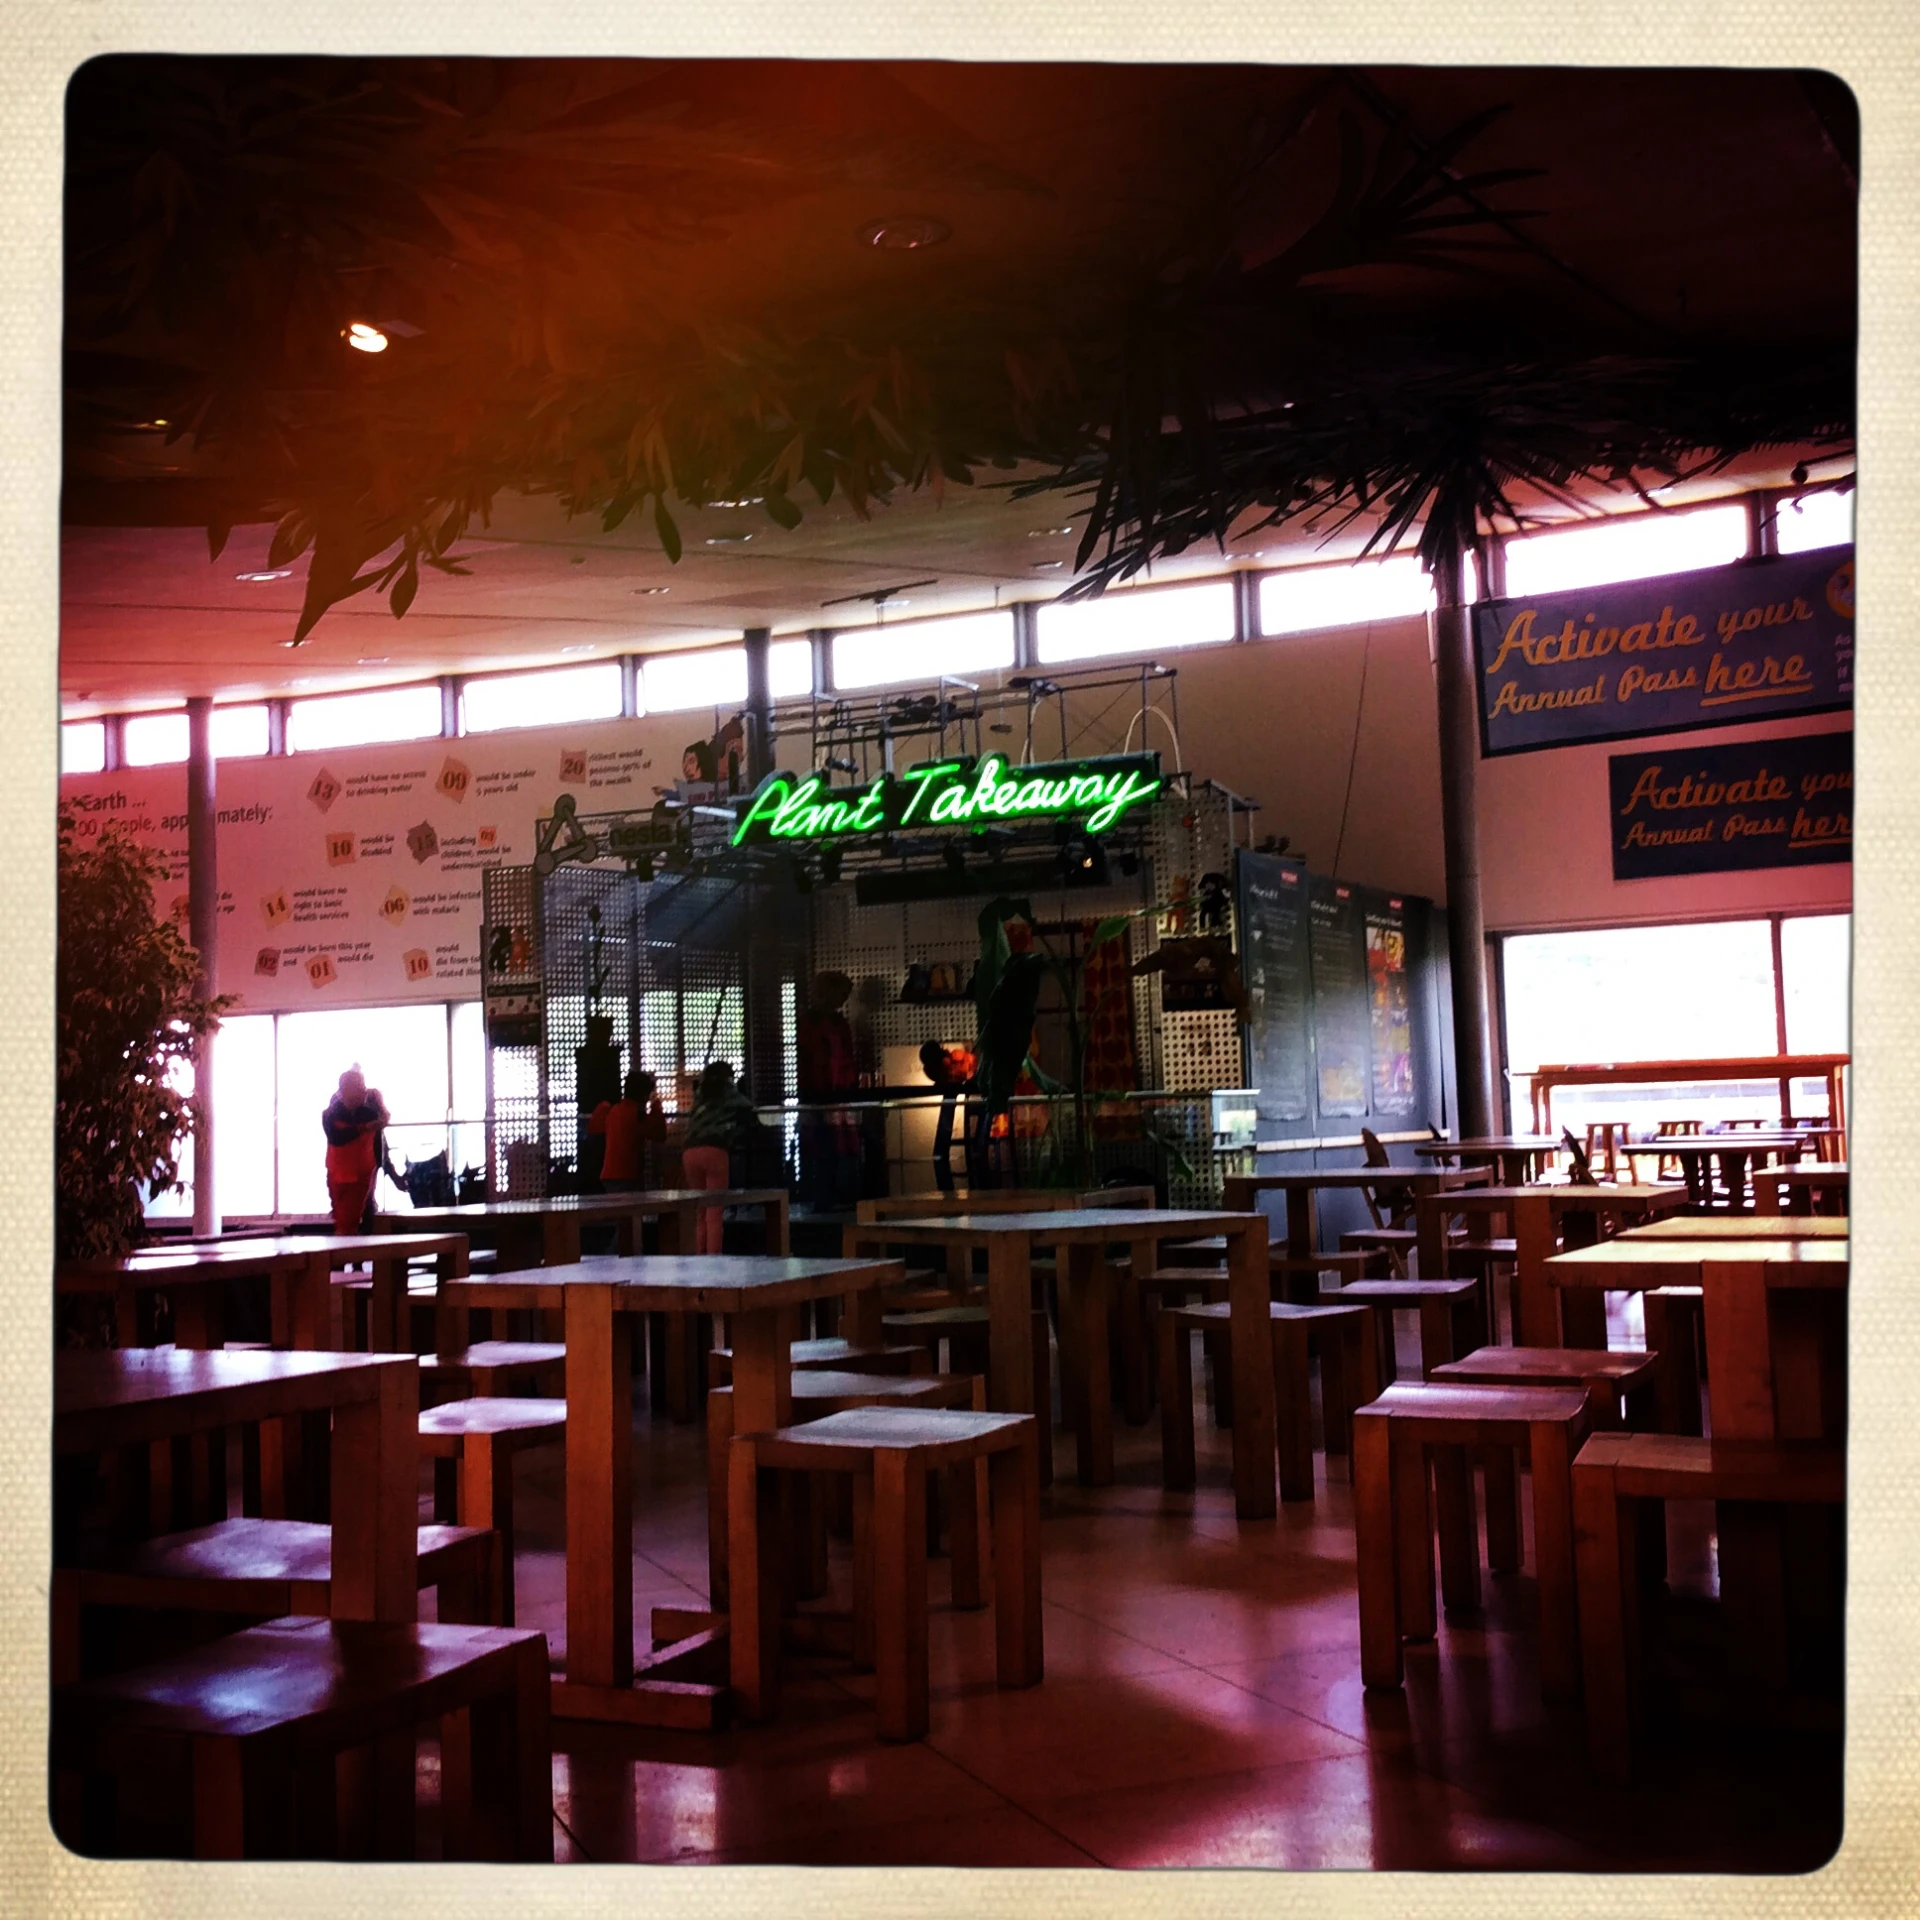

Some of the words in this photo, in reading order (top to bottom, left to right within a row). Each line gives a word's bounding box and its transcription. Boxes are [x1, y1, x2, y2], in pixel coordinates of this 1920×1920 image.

[1486, 604, 1705, 674] Activate
[1716, 597, 1813, 644] your
[1487, 675, 1606, 719] Annual
[1618, 664, 1696, 702] Pass
[1703, 652, 1813, 694] here
[563, 758, 585, 776] 20
[1621, 765, 1792, 815] Activate
[1801, 771, 1853, 800] you
[83, 789, 127, 812] Earth
[732, 778, 885, 847] Plant
[900, 757, 1161, 833] Takeaway
[332, 840, 352, 859] 10
[1621, 821, 1712, 849] Annual
[1722, 812, 1787, 841] Pass
[1791, 807, 1853, 838] her
